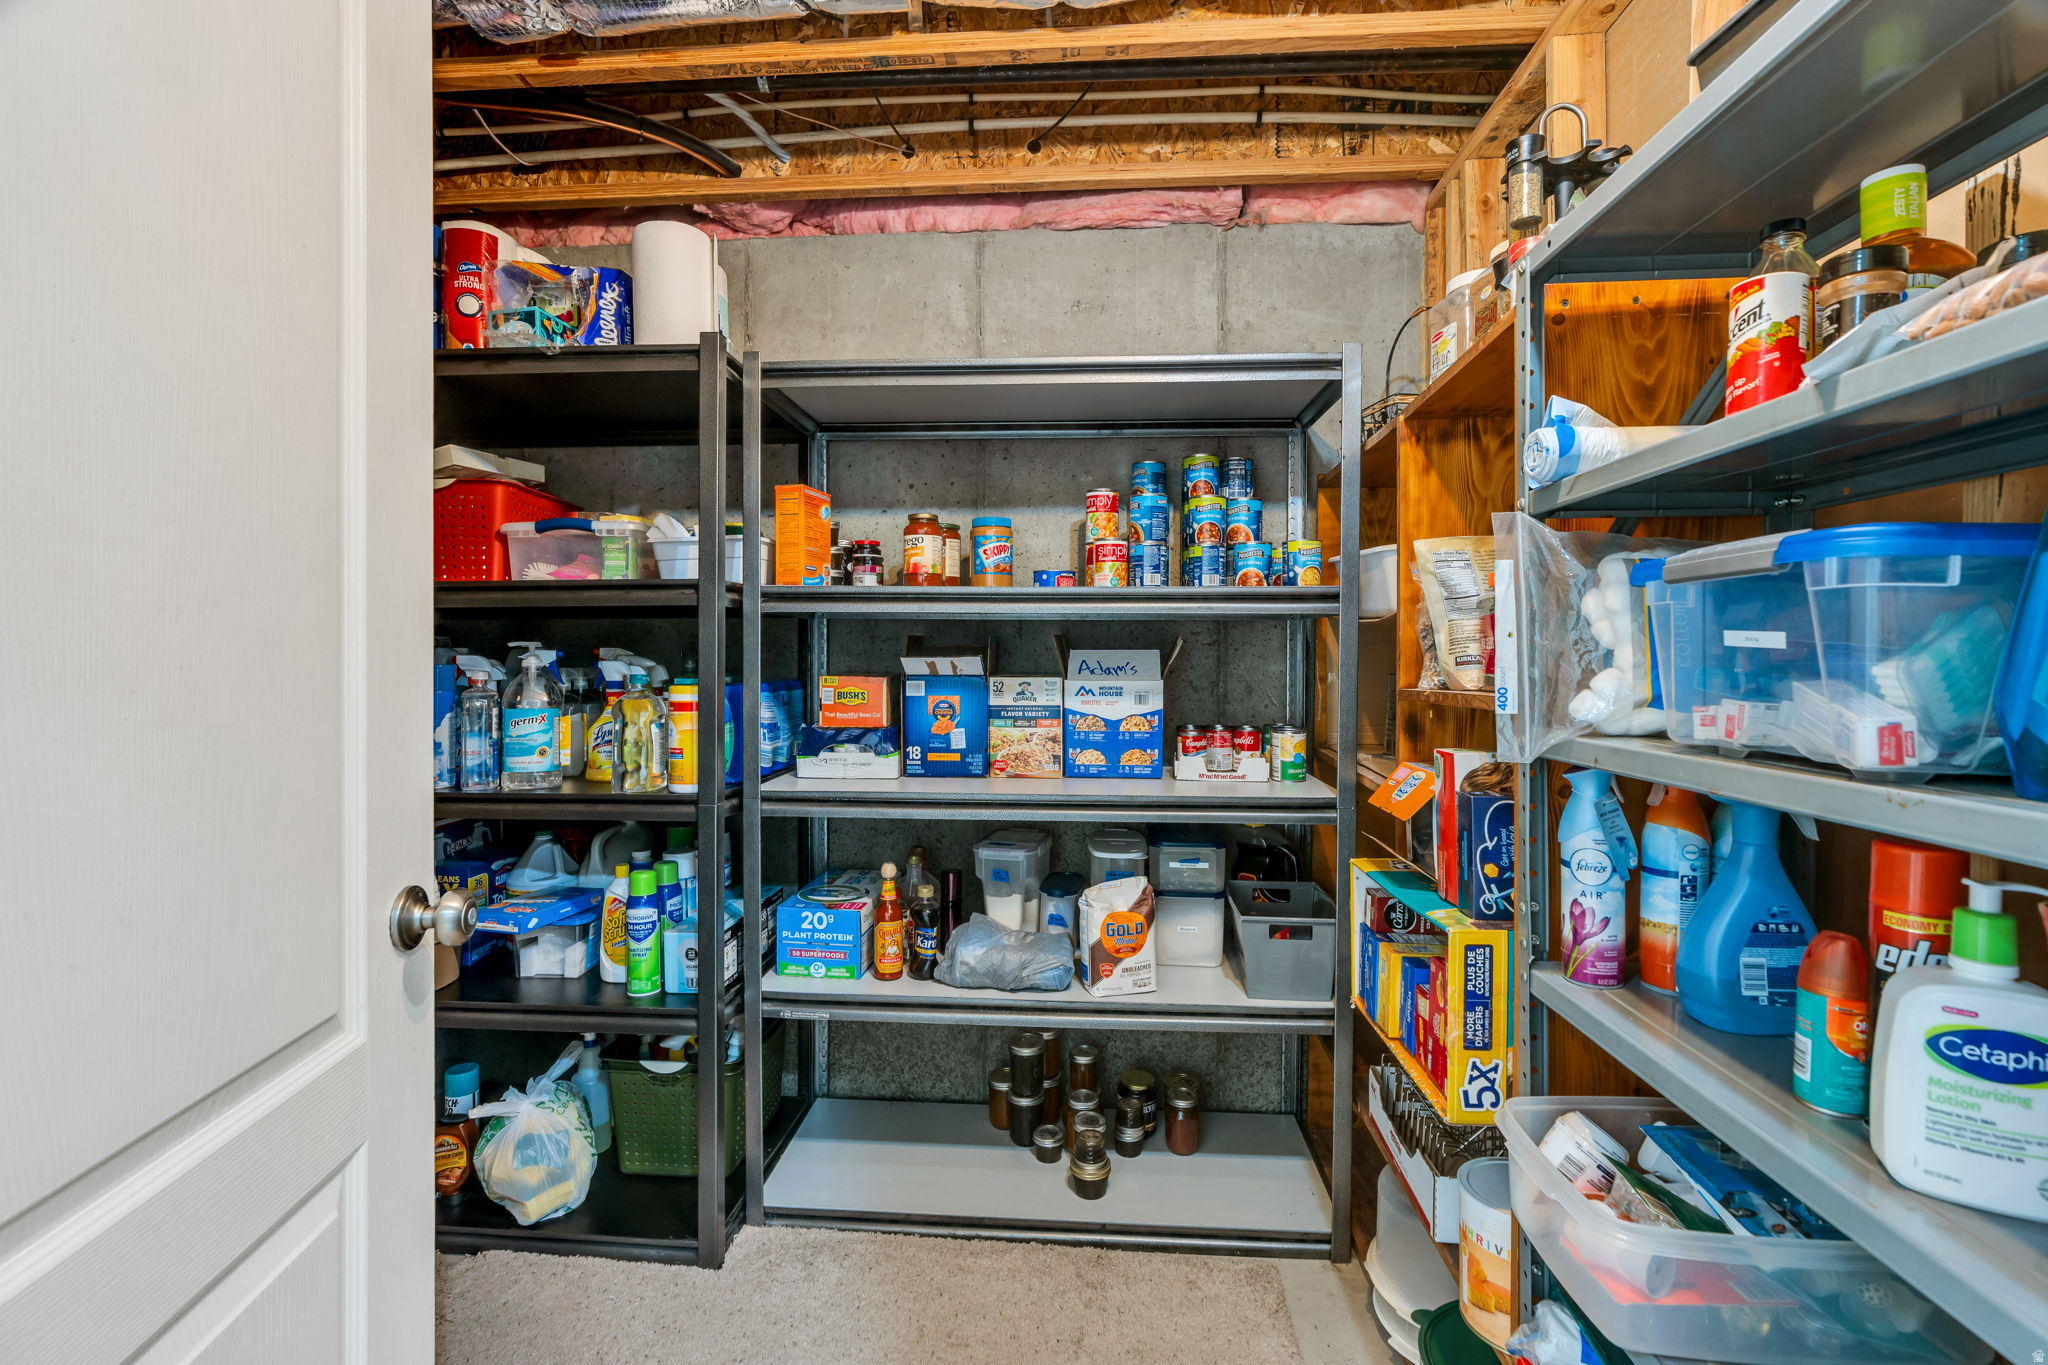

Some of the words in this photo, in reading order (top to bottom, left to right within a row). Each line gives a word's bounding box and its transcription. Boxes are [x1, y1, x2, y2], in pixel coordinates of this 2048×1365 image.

[1895, 188, 1906, 217] ZESTY
[1909, 182, 1919, 219] ITALIAN
[454, 280, 485, 291] STRONG
[1087, 495, 1113, 508] imply
[1197, 503, 1221, 512] PROGRESSO
[904, 537, 924, 548] rego
[1098, 545, 1128, 559] simply
[1078, 660, 1138, 676] Adam's
[993, 682, 1004, 693] 52
[837, 691, 866, 701] BUSH'S
[1497, 686, 1508, 712] 400
[906, 746, 921, 760] 18
[1576, 860, 1608, 873] febreze
[437, 875, 455, 883] EANS
[474, 877, 483, 888] 36
[492, 890, 506, 905] Toi
[1106, 922, 1144, 937] GOLD
[1883, 913, 1938, 933] ECONOMY
[604, 924, 627, 943] Scru
[782, 931, 812, 939] PLANT
[814, 933, 854, 941] PROTEIN
[917, 936, 937, 949] Karo
[1467, 950, 1475, 964] DE
[1121, 963, 1152, 974] UNBLEACHED
[1476, 948, 1484, 995] COUCHES
[1467, 966, 1475, 991] PLUS
[1467, 1011, 1475, 1039] MORE
[1475, 1006, 1483, 1046] DIAPERS
[1939, 1035, 2048, 1073] Cetaphi
[1462, 1060, 1501, 1109] 5X
[1926, 1075, 2033, 1110] Moisturizing
[1926, 1090, 1982, 1113] Lotion
